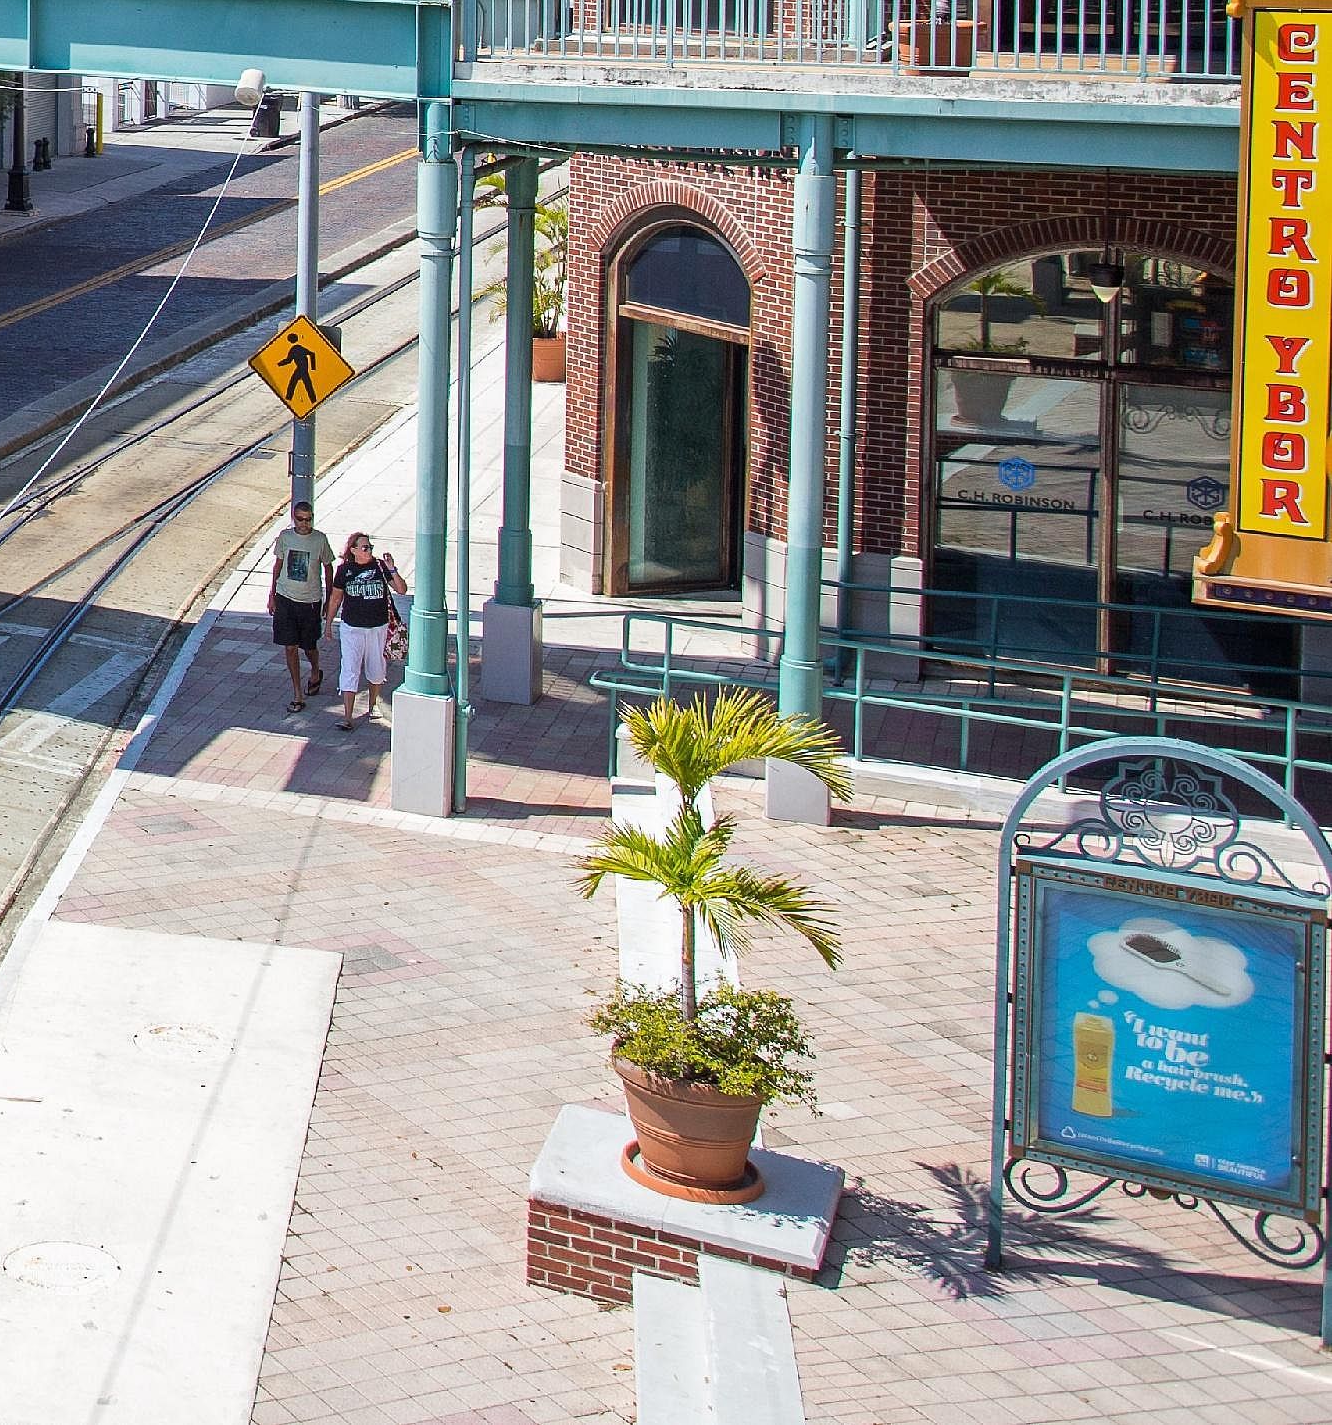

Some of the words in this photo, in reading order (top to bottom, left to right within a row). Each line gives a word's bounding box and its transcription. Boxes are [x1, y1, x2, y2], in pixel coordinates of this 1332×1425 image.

[1266, 21, 1318, 311] CENTRO
[1260, 335, 1311, 525] YBOR
[957, 489, 990, 502] C.H.
[992, 493, 1075, 511] ROBINSON
[1136, 1032, 1164, 1050] to
[1165, 1038, 1209, 1067] be
[1148, 1024, 1209, 1047] want
[1125, 1065, 1210, 1093] Recycle
[1141, 1059, 1155, 1069] a
[1157, 1060, 1249, 1088] hairbrush.
